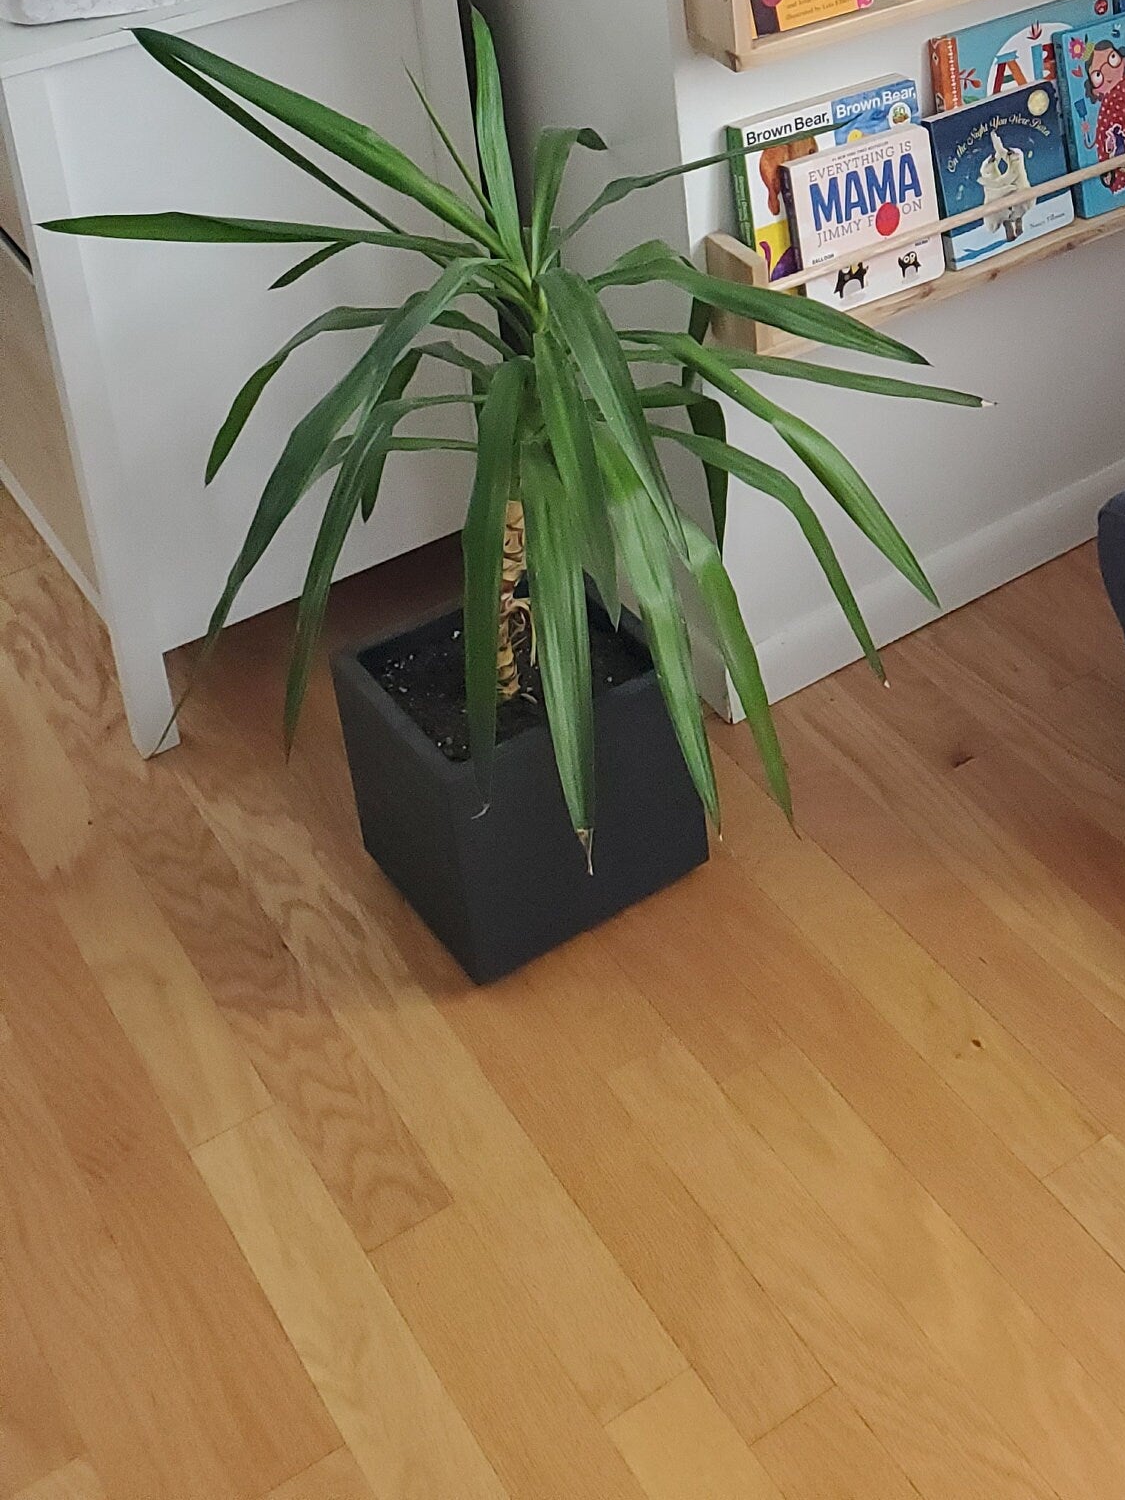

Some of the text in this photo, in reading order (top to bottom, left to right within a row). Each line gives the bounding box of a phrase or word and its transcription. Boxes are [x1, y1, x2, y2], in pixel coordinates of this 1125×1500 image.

[993, 43, 1056, 95] AB
[836, 86, 917, 119] Brown Bear,
[746, 111, 831, 146] Brown Bear,
[966, 122, 989, 146] Night
[989, 115, 1008, 130] You
[808, 141, 912, 183] EVERYTHING IS
[809, 153, 923, 232] MAMA
[817, 218, 862, 248] JIMMY
